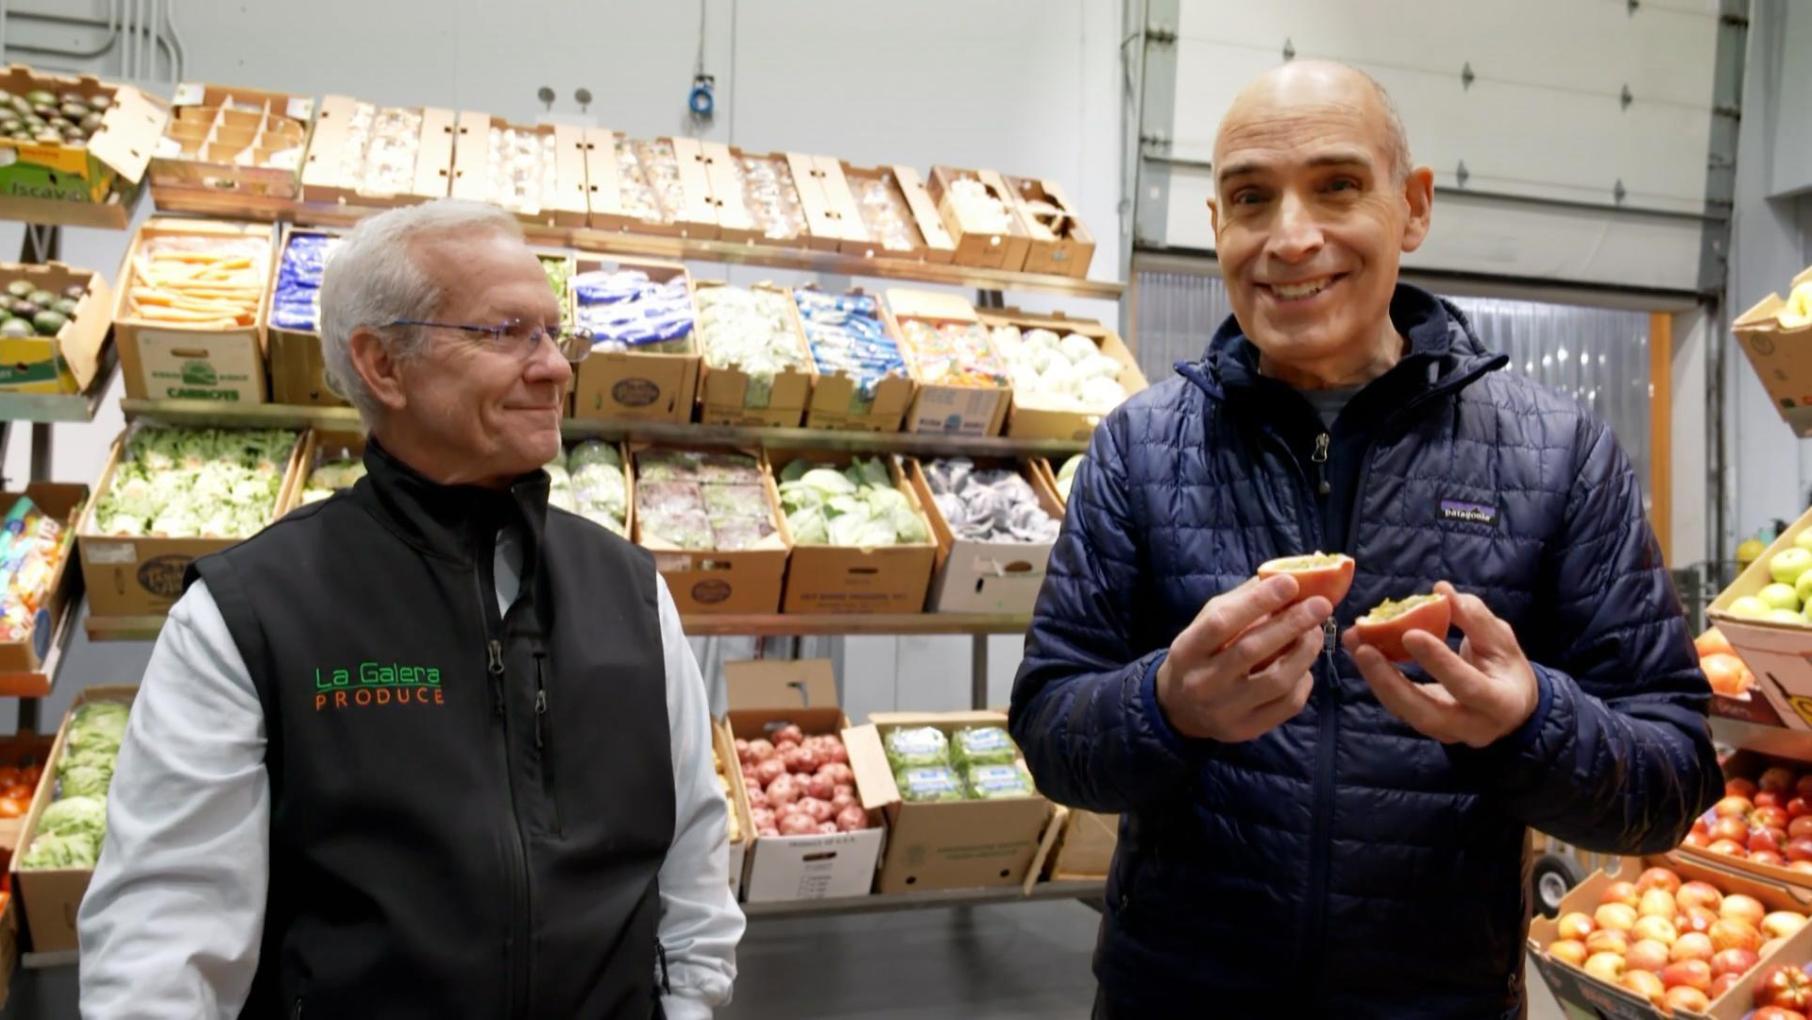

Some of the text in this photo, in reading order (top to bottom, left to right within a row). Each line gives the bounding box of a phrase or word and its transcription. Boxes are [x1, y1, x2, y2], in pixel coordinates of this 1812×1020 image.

[166, 387, 240, 401] CARROTS
[1444, 508, 1490, 522] patagonia
[316, 662, 440, 688] La Galera
[315, 687, 445, 711] PRODUCE
